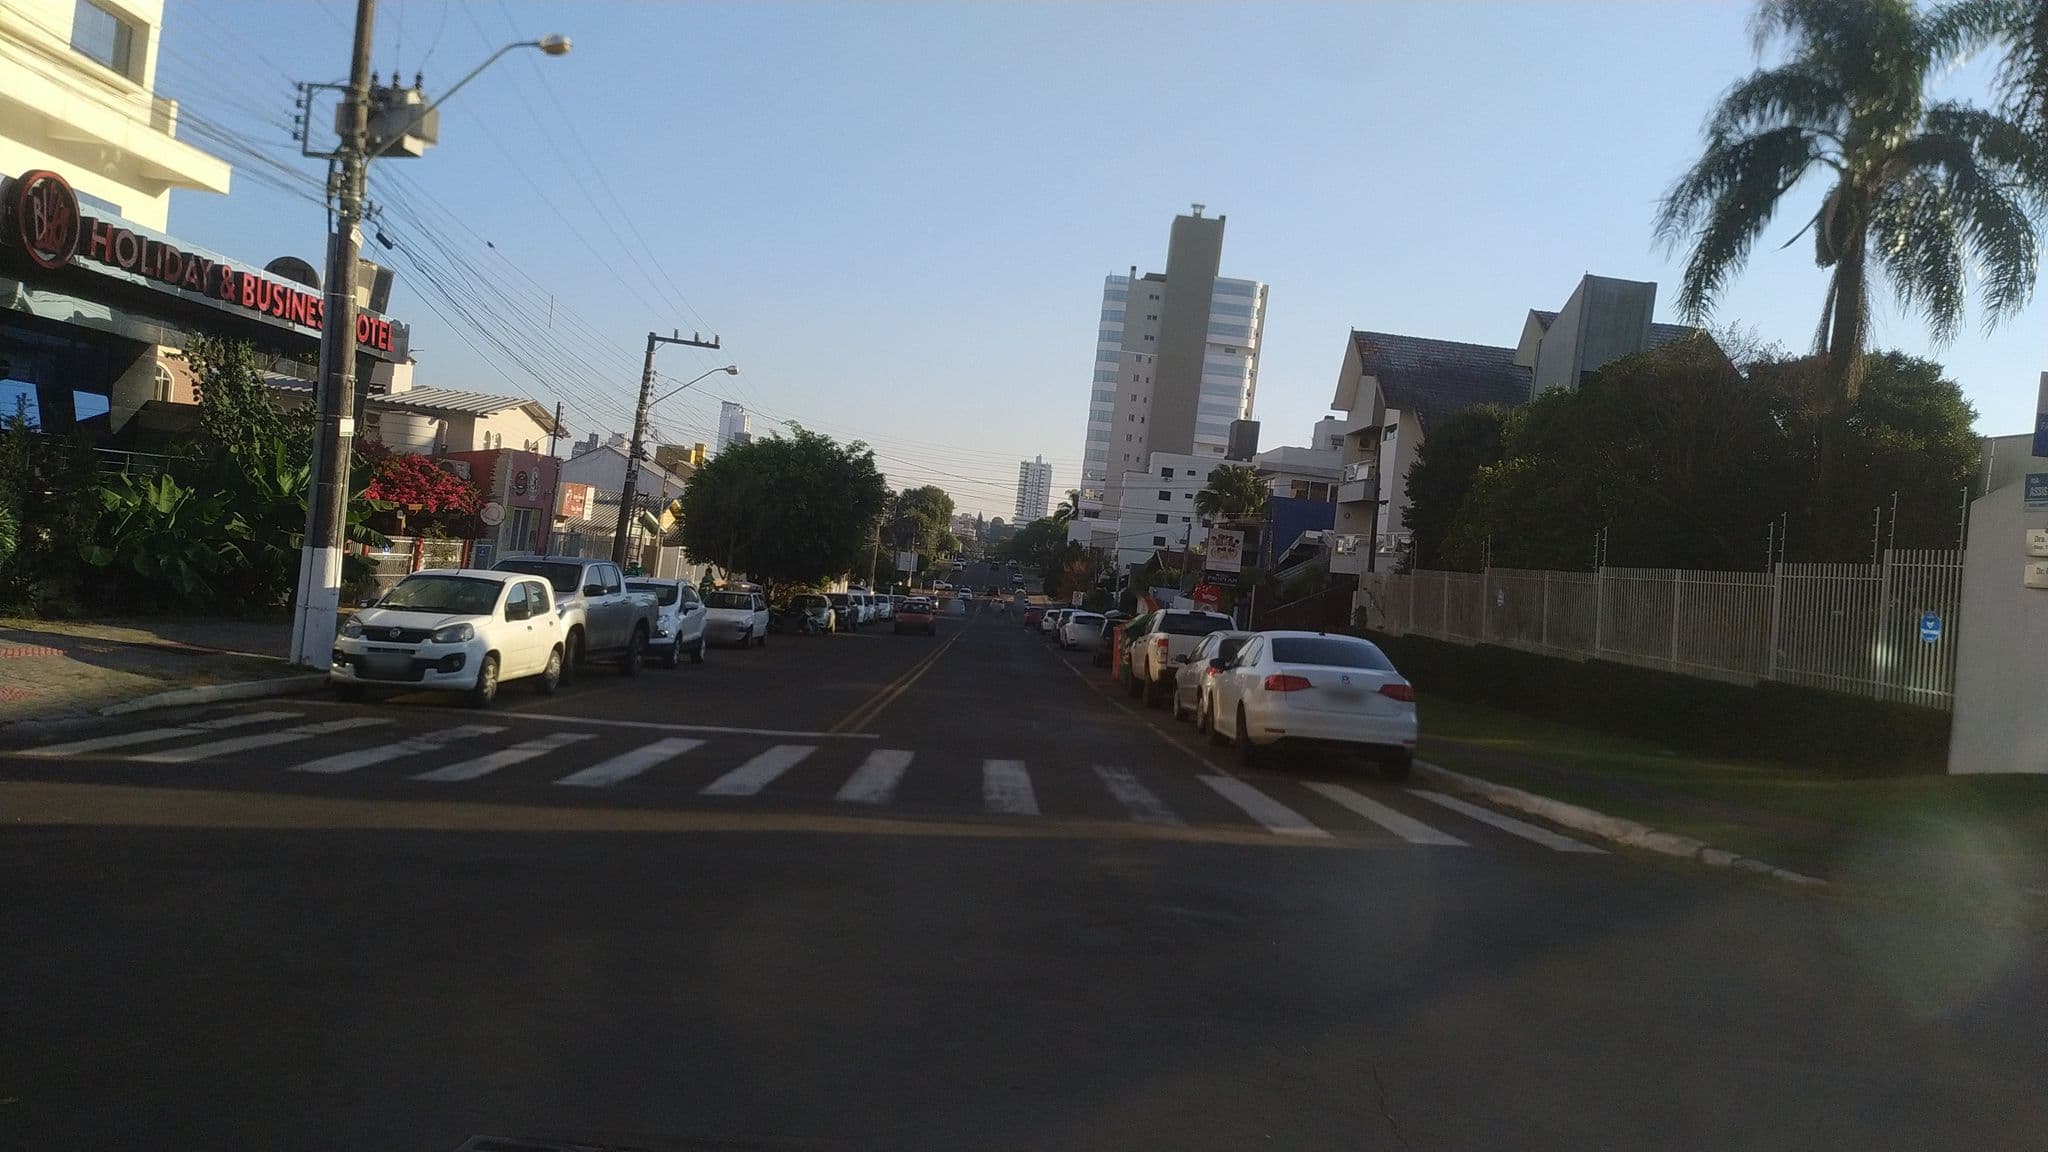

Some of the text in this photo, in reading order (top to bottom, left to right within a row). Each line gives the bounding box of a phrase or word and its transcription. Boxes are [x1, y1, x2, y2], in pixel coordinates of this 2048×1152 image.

[91, 218, 395, 352] HOLIDAY & BUSINES OTEL
